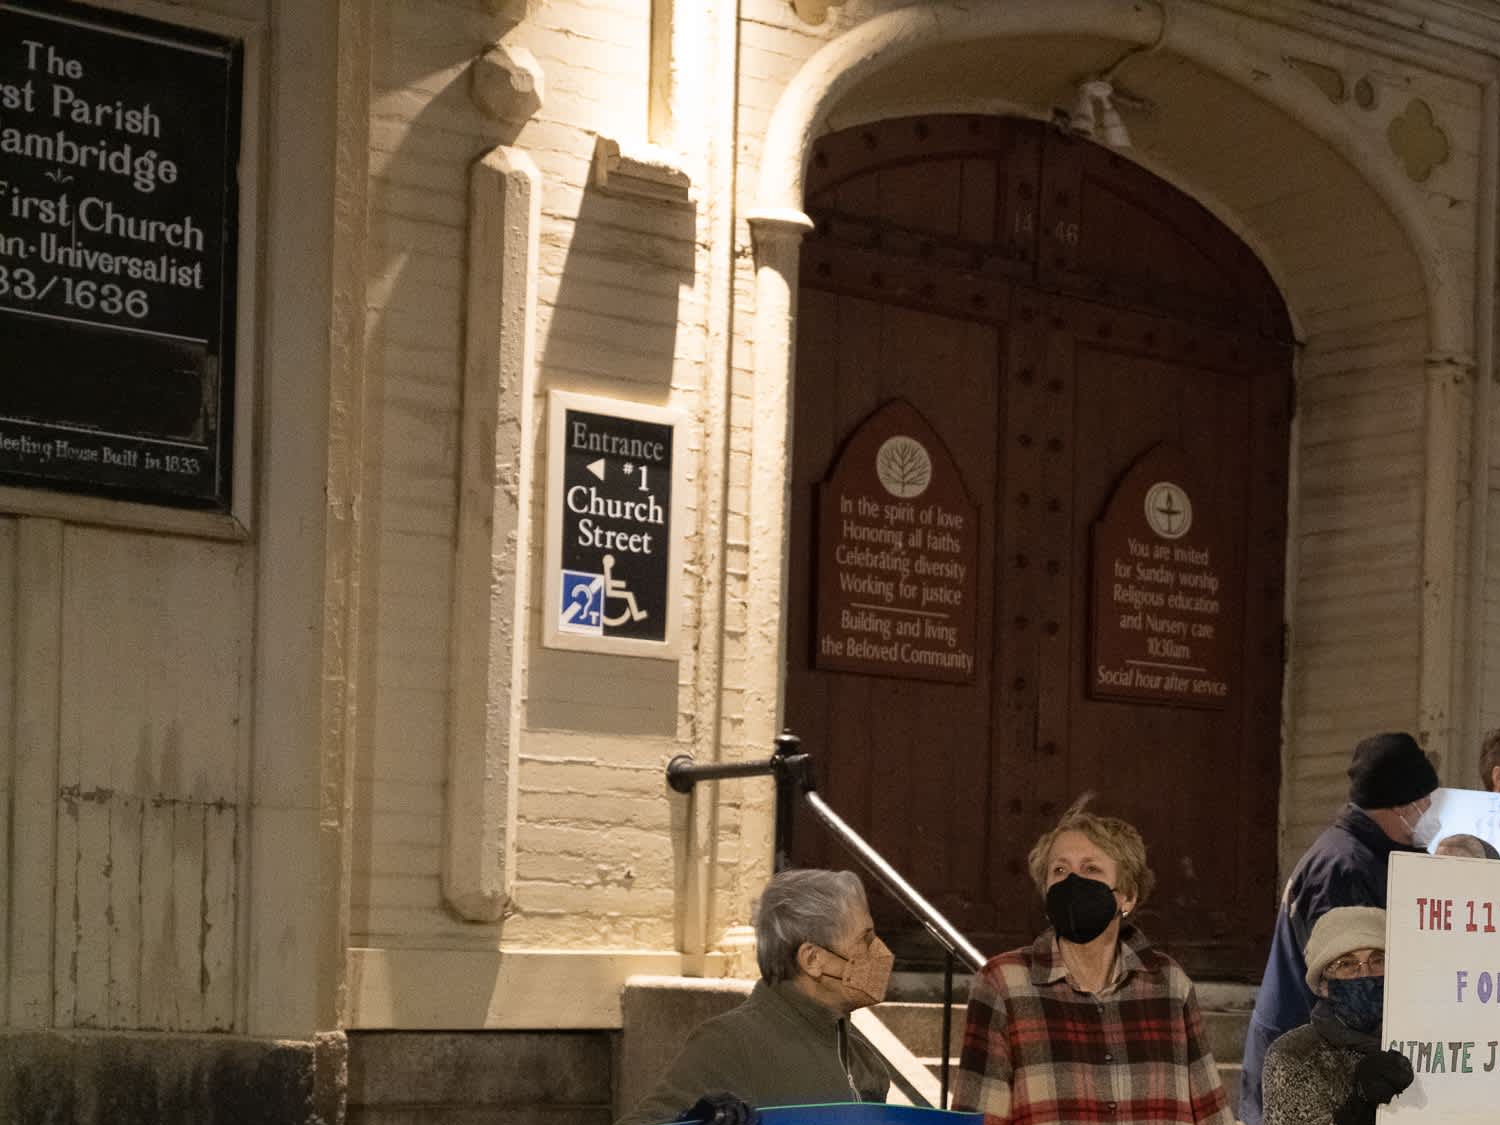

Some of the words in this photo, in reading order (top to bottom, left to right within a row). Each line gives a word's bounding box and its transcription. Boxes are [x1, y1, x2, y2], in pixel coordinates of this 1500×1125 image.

[21, 40, 82, 79] The
[52, 84, 160, 139] Parish
[0, 128, 178, 192] ambridge
[0, 180, 75, 229] irst
[79, 196, 204, 251] Church
[0, 433, 50, 456] eeting
[55, 440, 99, 462] House
[102, 447, 139, 467] Built
[144, 453, 160, 470] in
[165, 456, 200, 474] 1833
[571, 421, 664, 461] Entrance
[623, 462, 649, 491] #1
[567, 485, 664, 524] Church
[840, 496, 853, 513] In
[858, 497, 880, 518] the
[884, 503, 914, 527] spirit
[920, 505, 934, 525] of
[937, 507, 963, 529] love
[578, 519, 652, 554] Street
[843, 521, 903, 551] Honoring
[908, 529, 922, 548] all
[927, 533, 960, 553] faiths
[1128, 538, 1149, 556] You
[1153, 544, 1171, 561] are
[1174, 547, 1209, 566] invited
[836, 546, 910, 575] Celebrating
[914, 553, 966, 584] diversity
[1114, 561, 1131, 578] for
[1136, 563, 1175, 585] Sunday
[1179, 571, 1219, 595] worship
[840, 573, 893, 602] Working
[899, 578, 917, 599] for
[922, 583, 961, 606] justice
[1113, 585, 1164, 609] Religious
[1168, 593, 1219, 614] education
[841, 610, 891, 639] Building
[896, 615, 920, 636] and
[924, 618, 957, 647] living
[1119, 613, 1142, 631] and
[1146, 615, 1188, 637] Nursery
[821, 635, 843, 656] the
[846, 638, 898, 662] Beloved
[900, 644, 973, 673] Community
[1097, 665, 1132, 687] Social
[1135, 670, 1162, 689] hour
[1165, 673, 1188, 693] after
[1192, 678, 1227, 696] service
[1416, 897, 1452, 931] THE
[1389, 1039, 1475, 1073] IMATE
